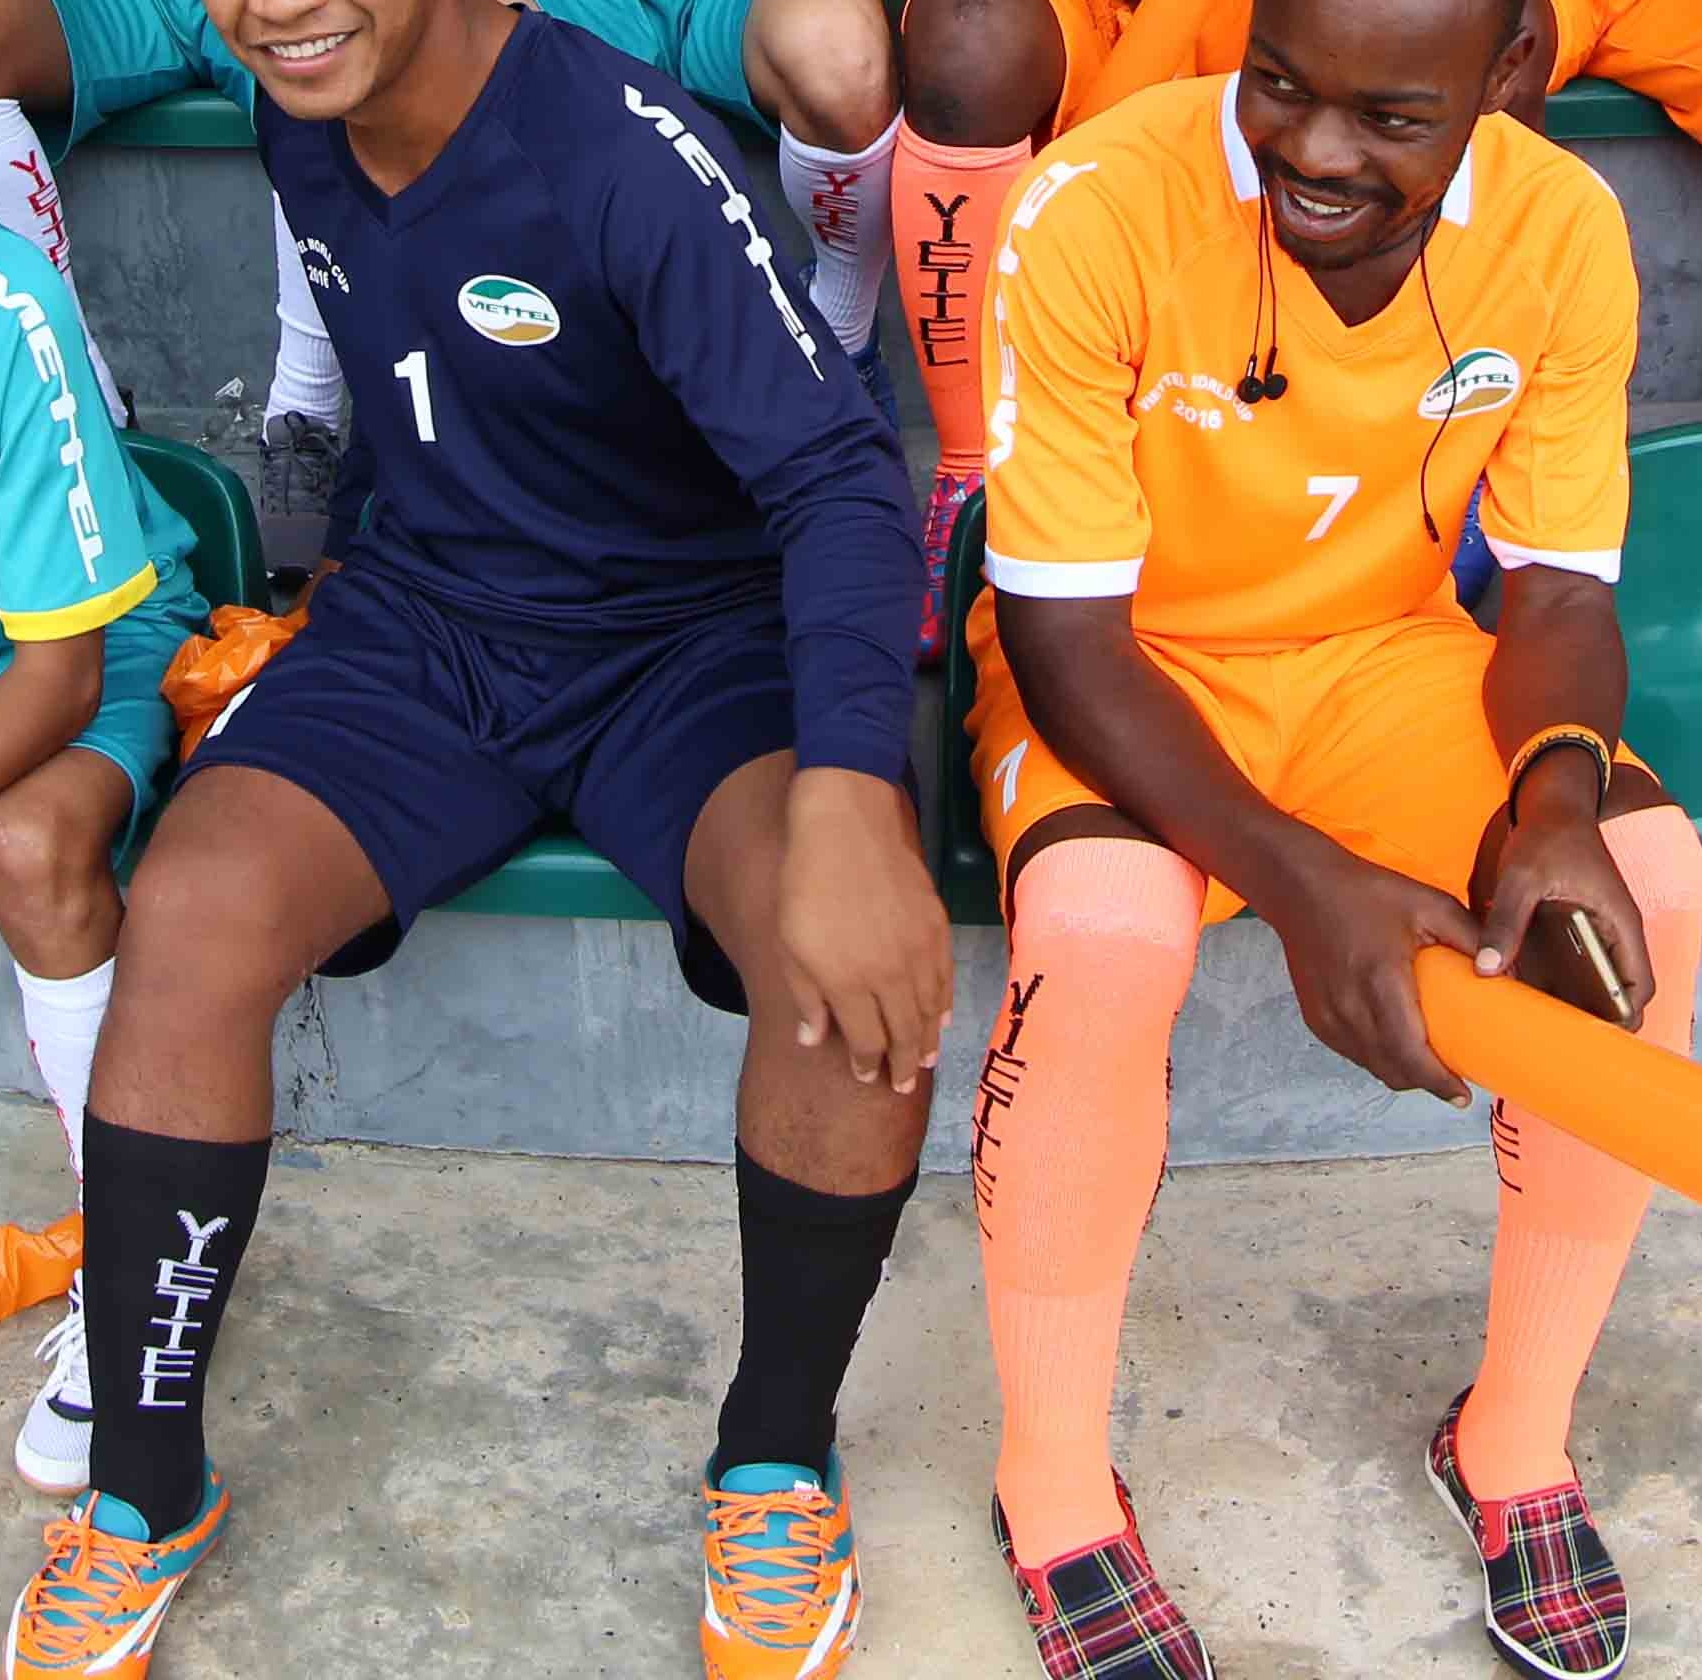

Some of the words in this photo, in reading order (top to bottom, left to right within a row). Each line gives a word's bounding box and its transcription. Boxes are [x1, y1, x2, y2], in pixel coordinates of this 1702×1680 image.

[622, 83, 825, 384] VIETTEL
[306, 263, 331, 289] 2016
[331, 264, 351, 294] CUP
[465, 298, 555, 324] VIETTEL
[990, 161, 1098, 471] VIETTEL
[393, 349, 437, 443] 1
[1137, 371, 1186, 414] VIETTEL
[1425, 371, 1517, 403] VIETTEL
[1172, 399, 1224, 430] 2016
[1305, 474, 1361, 542] 7
